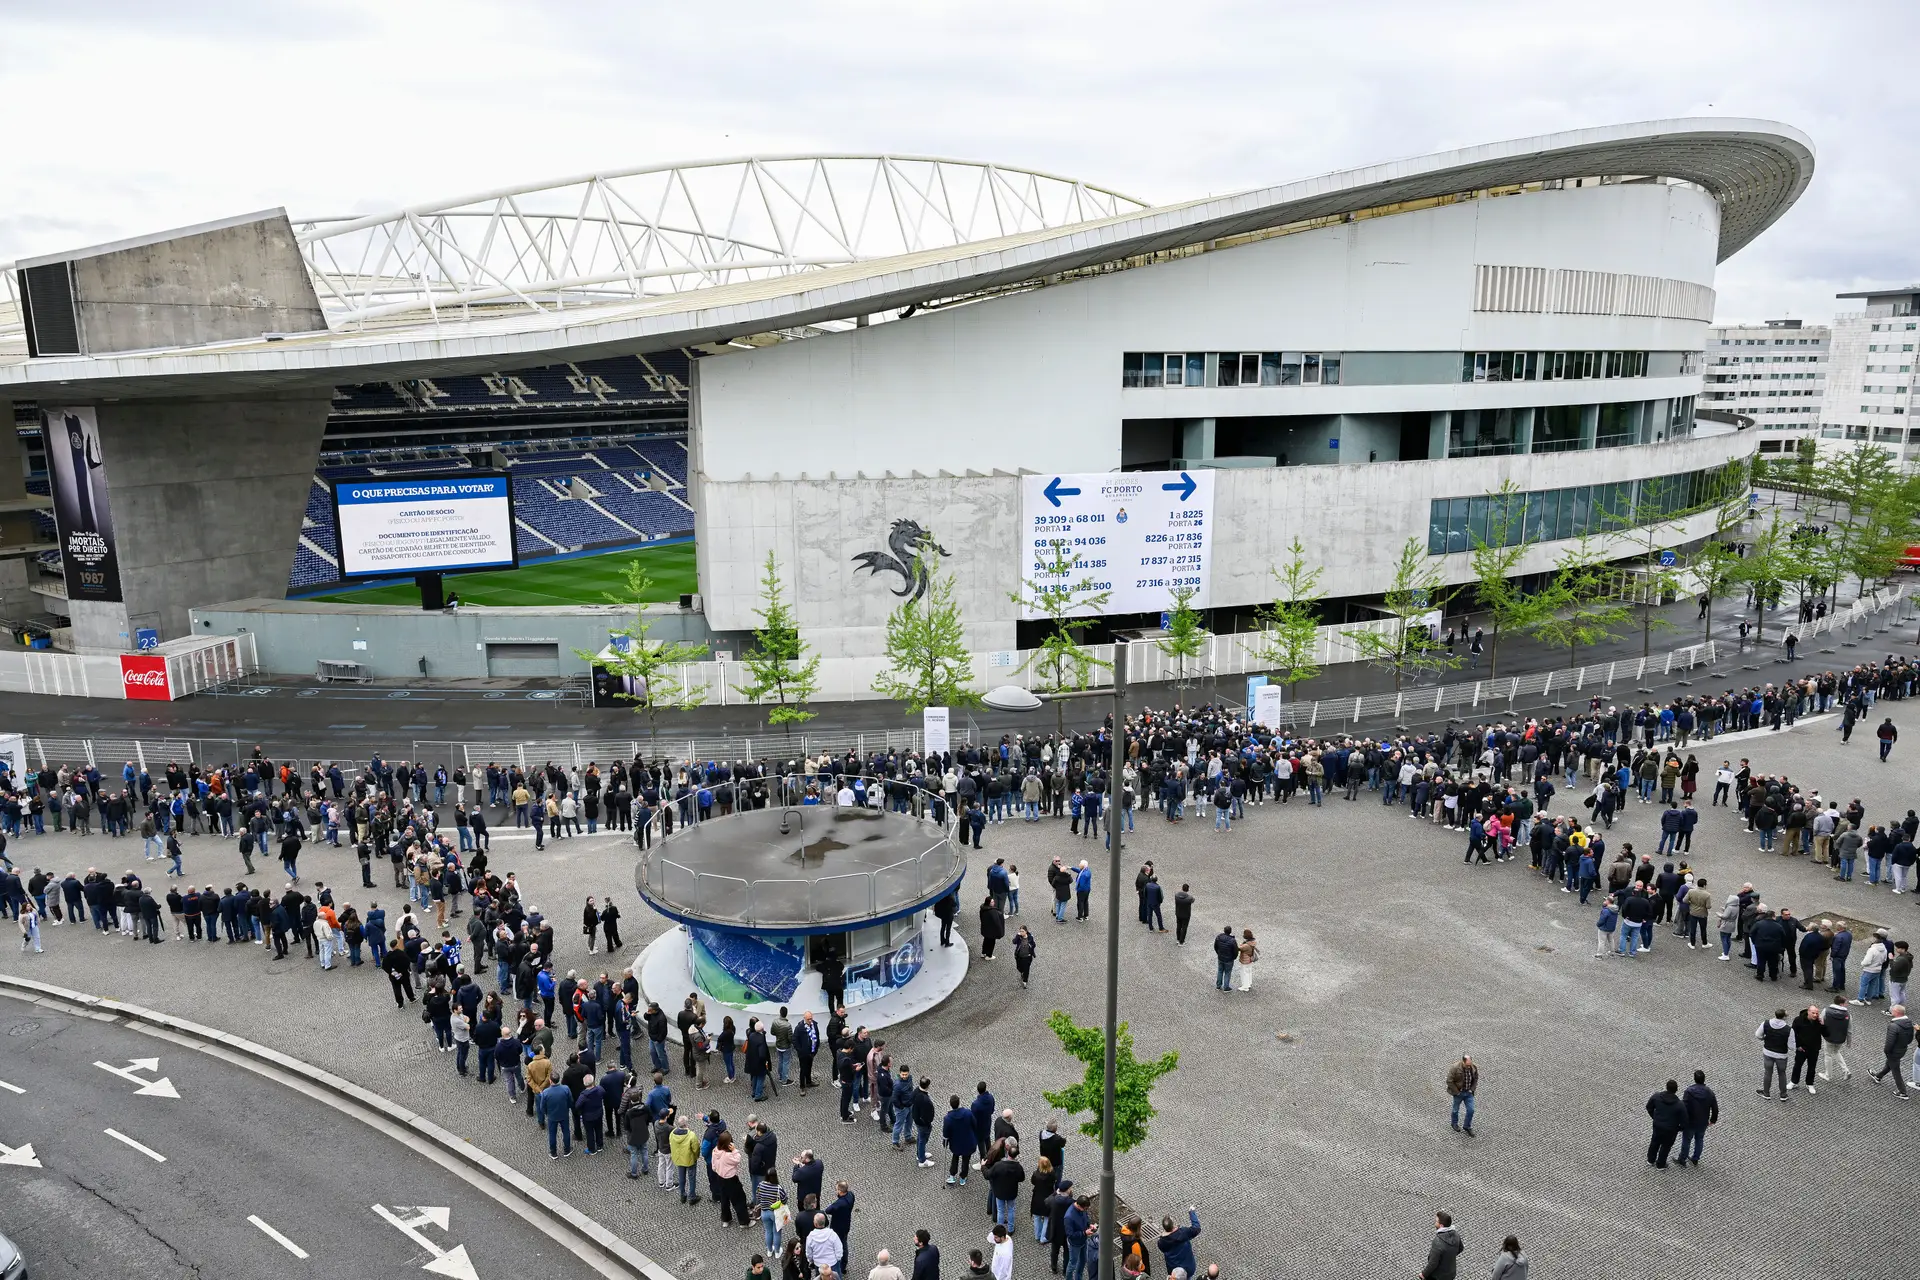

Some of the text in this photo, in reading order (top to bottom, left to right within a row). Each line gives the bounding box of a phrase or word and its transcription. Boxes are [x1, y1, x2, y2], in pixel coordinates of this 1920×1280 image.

[352, 484, 494, 499] O QUE PRECISAS PARA VOTAR?
[1183, 510, 1203, 518] 8225
[1035, 516, 1046, 524] 39
[430, 528, 478, 536] IDENTIFICAÇÃO
[69, 537, 104, 546] IMORTAIS
[1089, 537, 1106, 545] 036
[1663, 557, 1675, 565] 27
[80, 572, 104, 584] 1987
[1094, 582, 1111, 590] 500
[1414, 597, 1427, 606] 26
[141, 636, 157, 648] 23
[618, 643, 629, 652] 24
[124, 669, 165, 686] Coca-Cola
[450, 944, 462, 957] 25
